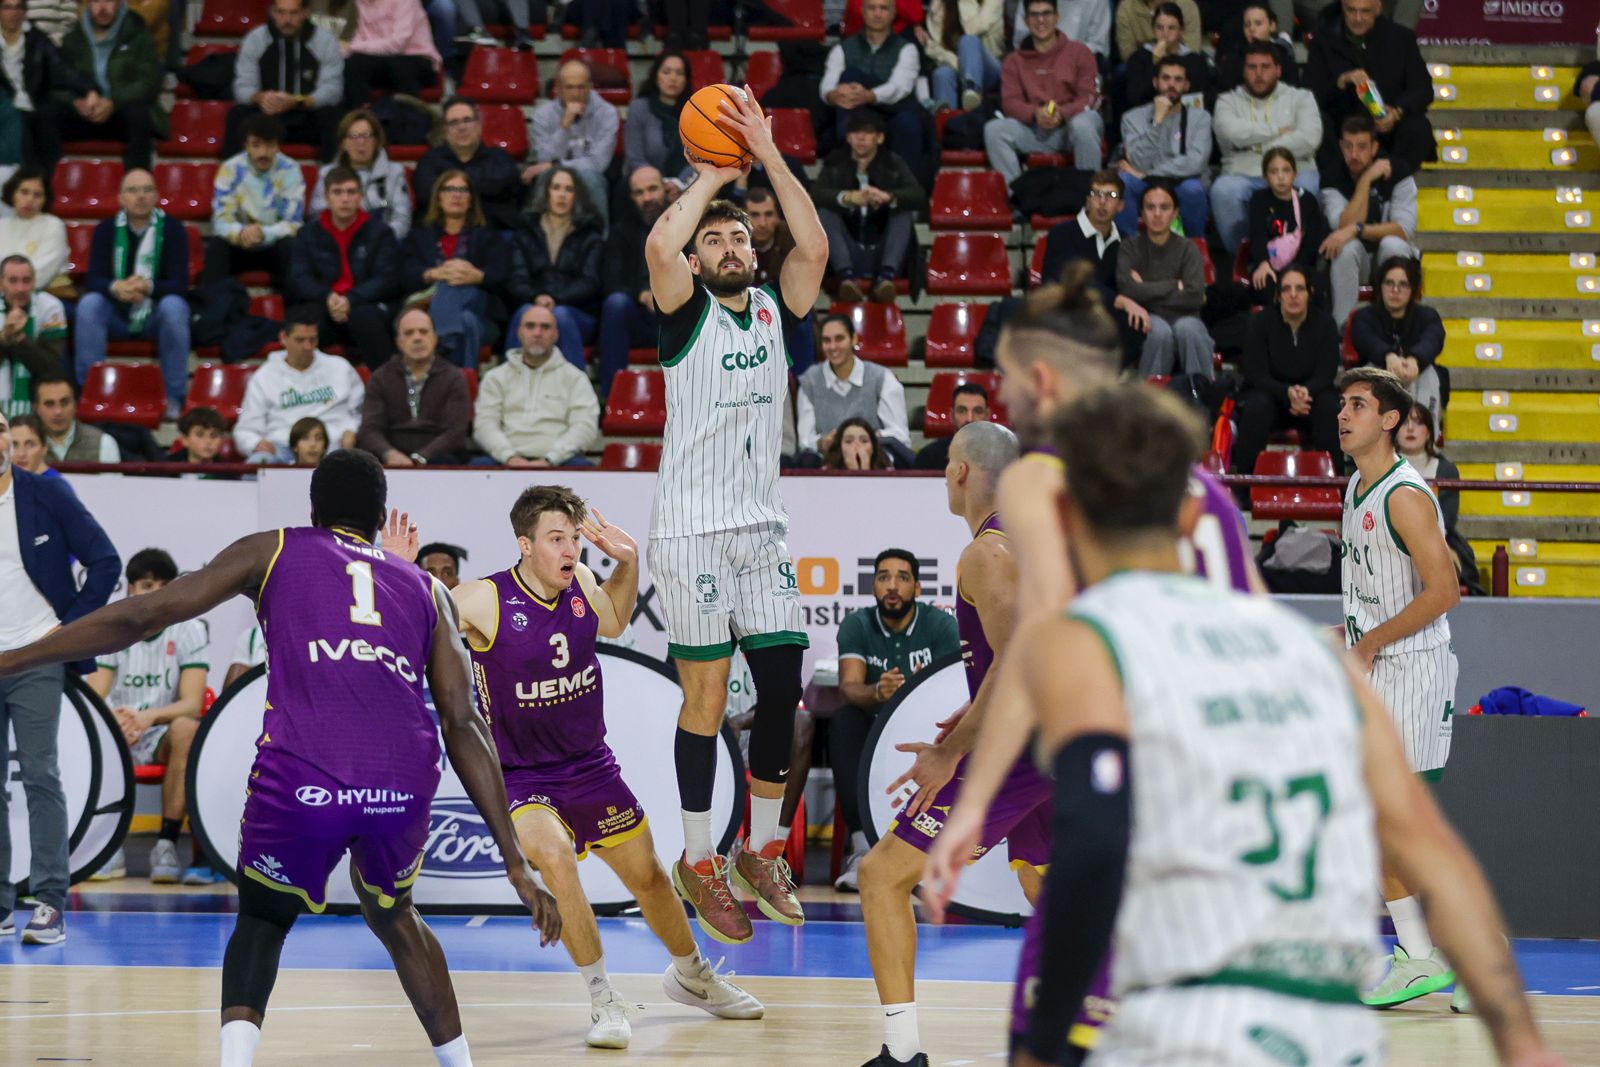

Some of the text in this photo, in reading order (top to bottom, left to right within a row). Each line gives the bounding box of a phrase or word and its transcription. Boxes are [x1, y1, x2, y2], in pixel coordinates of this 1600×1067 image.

[1501, 0, 1564, 17] IMDECO
[346, 560, 383, 627] 1
[548, 632, 570, 669] 3
[515, 665, 597, 700] UEMC
[914, 811, 944, 834] CBC
